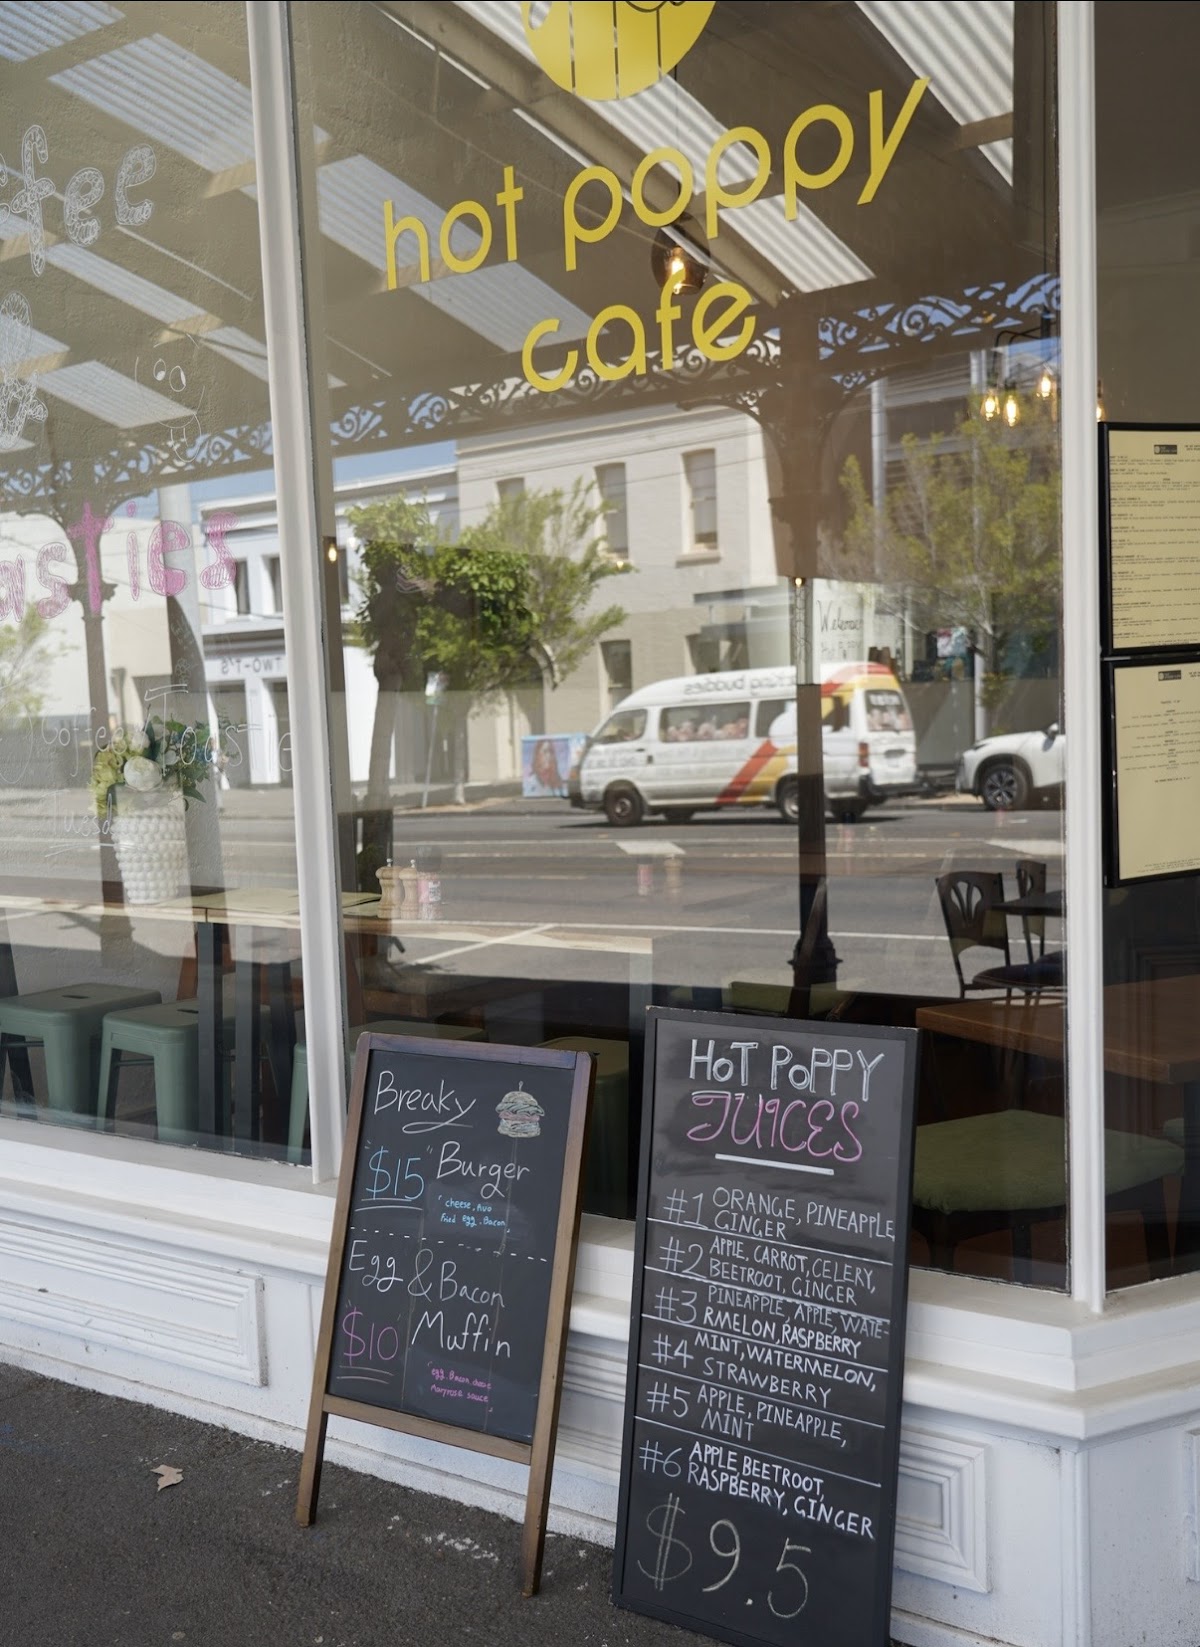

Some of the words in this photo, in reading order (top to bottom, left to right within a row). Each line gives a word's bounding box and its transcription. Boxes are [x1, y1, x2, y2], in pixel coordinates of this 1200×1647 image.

[383, 166, 523, 291] hot
[563, 77, 931, 272] poppy
[521, 269, 756, 393] cafe
[374, 1070, 476, 1134] Breaky
[686, 1090, 863, 1162] JUICES
[365, 1145, 424, 1200] $15
[437, 1141, 530, 1199] Burger
[663, 1188, 708, 1230] #1
[712, 1186, 802, 1226] ORANGE,
[714, 1209, 786, 1241] GINGER
[349, 1240, 403, 1292] Egg
[407, 1248, 433, 1302] &
[440, 1260, 505, 1308] Bacon
[659, 1236, 707, 1280] #2
[709, 1235, 749, 1262] APPLE,
[754, 1245, 810, 1277] CARROT,
[812, 1258, 876, 1294] CELERY,
[709, 1257, 786, 1295] BEETROOT,
[791, 1276, 857, 1306] GINGER
[342, 1306, 399, 1367] $10
[411, 1310, 511, 1358] Muffin
[654, 1286, 698, 1325] #3
[708, 1285, 790, 1324] PINEAPPLE,
[793, 1303, 837, 1335] APPLE,
[651, 1333, 694, 1368] #4
[694, 1331, 745, 1361] MINT,
[746, 1343, 876, 1392] WATERMELON,
[781, 1323, 862, 1359] RASPBERRY
[703, 1356, 831, 1409] STRAWBERRY
[647, 1381, 691, 1418] #5
[697, 1384, 752, 1419] APPLE,
[757, 1401, 847, 1448] PINEAPPLE,
[701, 1408, 755, 1441] MINT
[639, 1440, 682, 1477] #6
[687, 1462, 788, 1516] RASPBERRY,
[794, 1495, 875, 1540] GINGER
